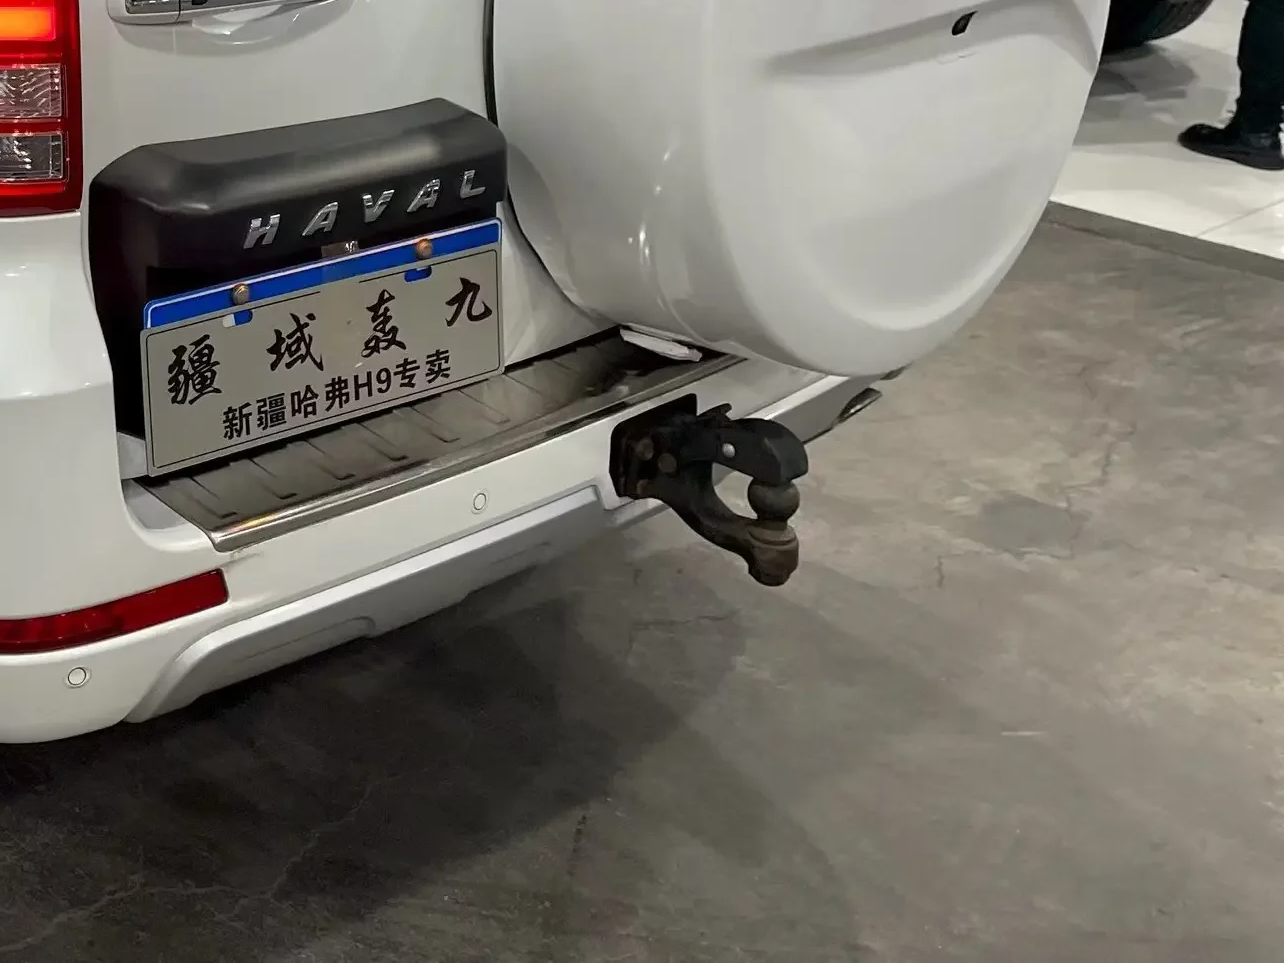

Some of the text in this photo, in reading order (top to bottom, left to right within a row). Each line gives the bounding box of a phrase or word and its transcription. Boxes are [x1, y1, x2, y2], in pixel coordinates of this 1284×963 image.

[242, 169, 487, 249] HAVAL
[166, 277, 493, 406] 疆域轰九
[222, 349, 452, 440] 新疆哈弗H9专卖
